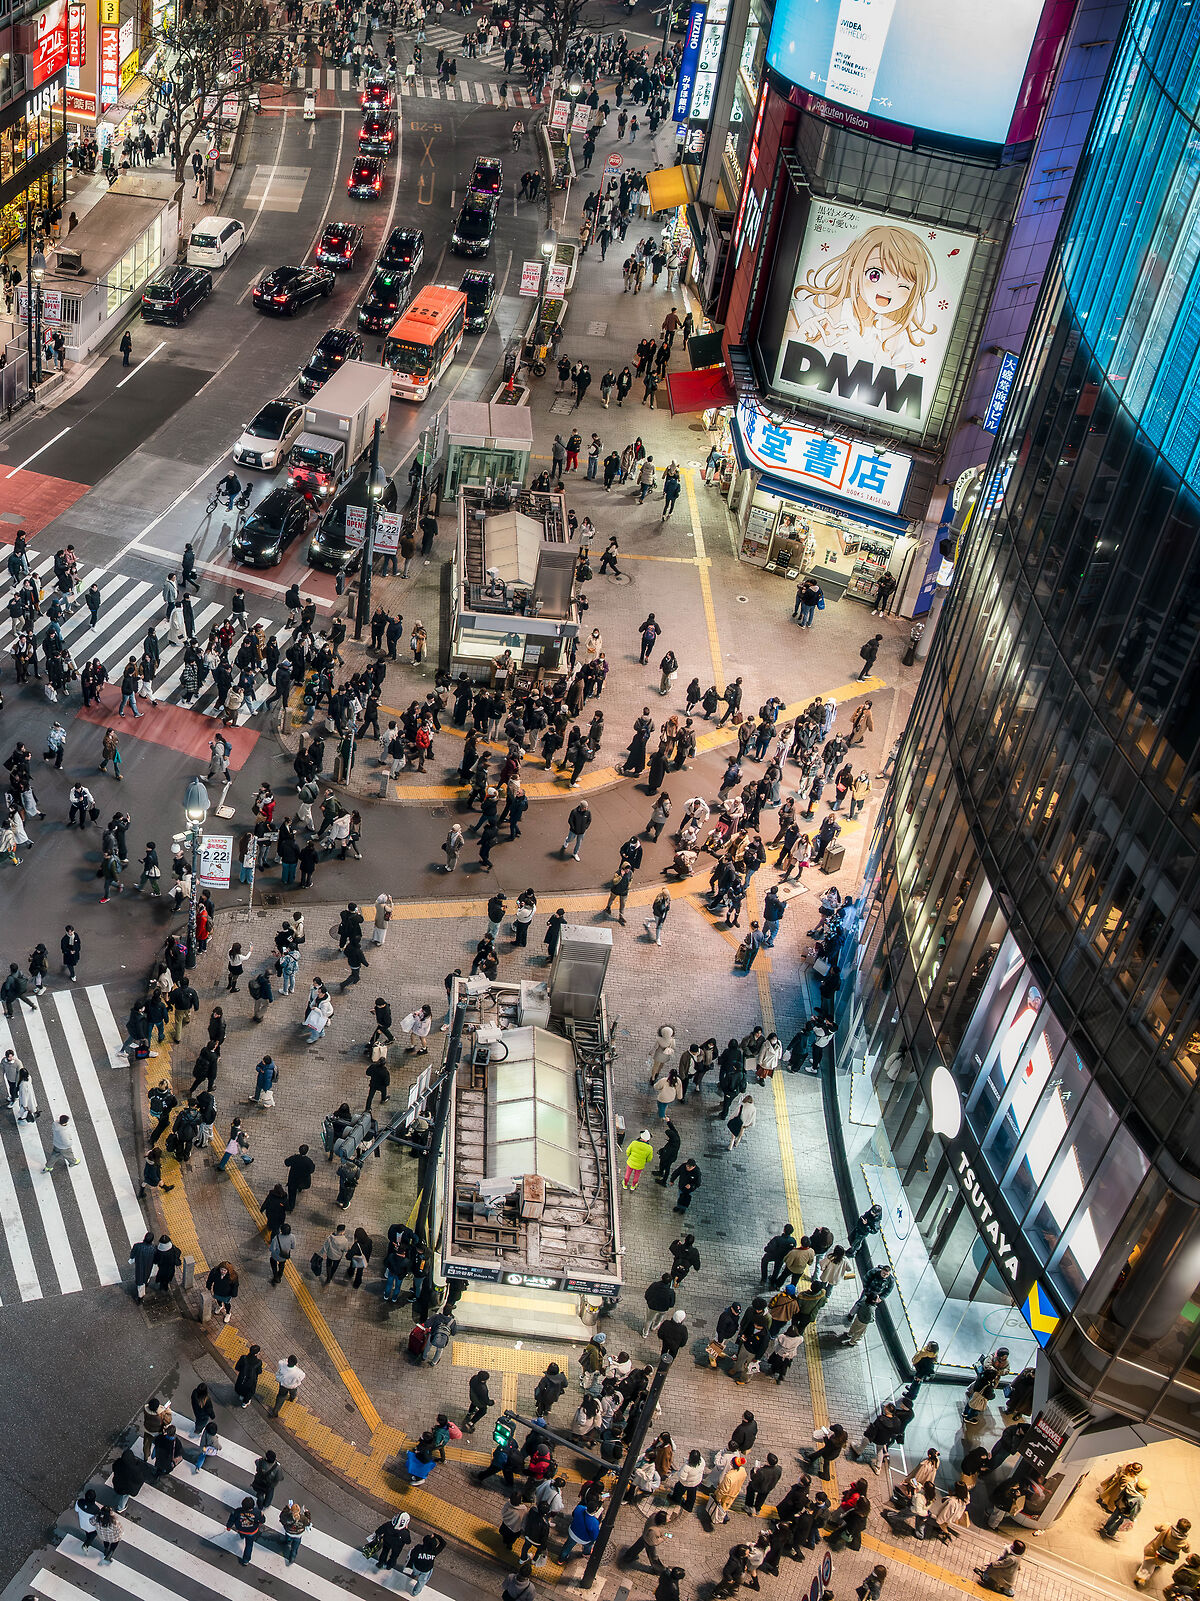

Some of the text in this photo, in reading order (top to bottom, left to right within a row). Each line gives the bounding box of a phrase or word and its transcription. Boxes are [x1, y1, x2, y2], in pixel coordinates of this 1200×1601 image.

[39, 30, 62, 62] アコム
[690, 12, 704, 50] MIZUHO
[26, 80, 59, 123] LUSH
[677, 75, 691, 114] みずほ銀行
[814, 101, 869, 129] Rakuten Vision
[780, 340, 924, 420] DMM
[846, 488, 864, 500] BOOKS
[811, 503, 850, 518] TAISEIDO
[202, 851, 227, 861] 2/22
[956, 1150, 1020, 1282] TSUTAYA
[1037, 1419, 1062, 1446] MARVEL
[1025, 1447, 1045, 1467] B1F
